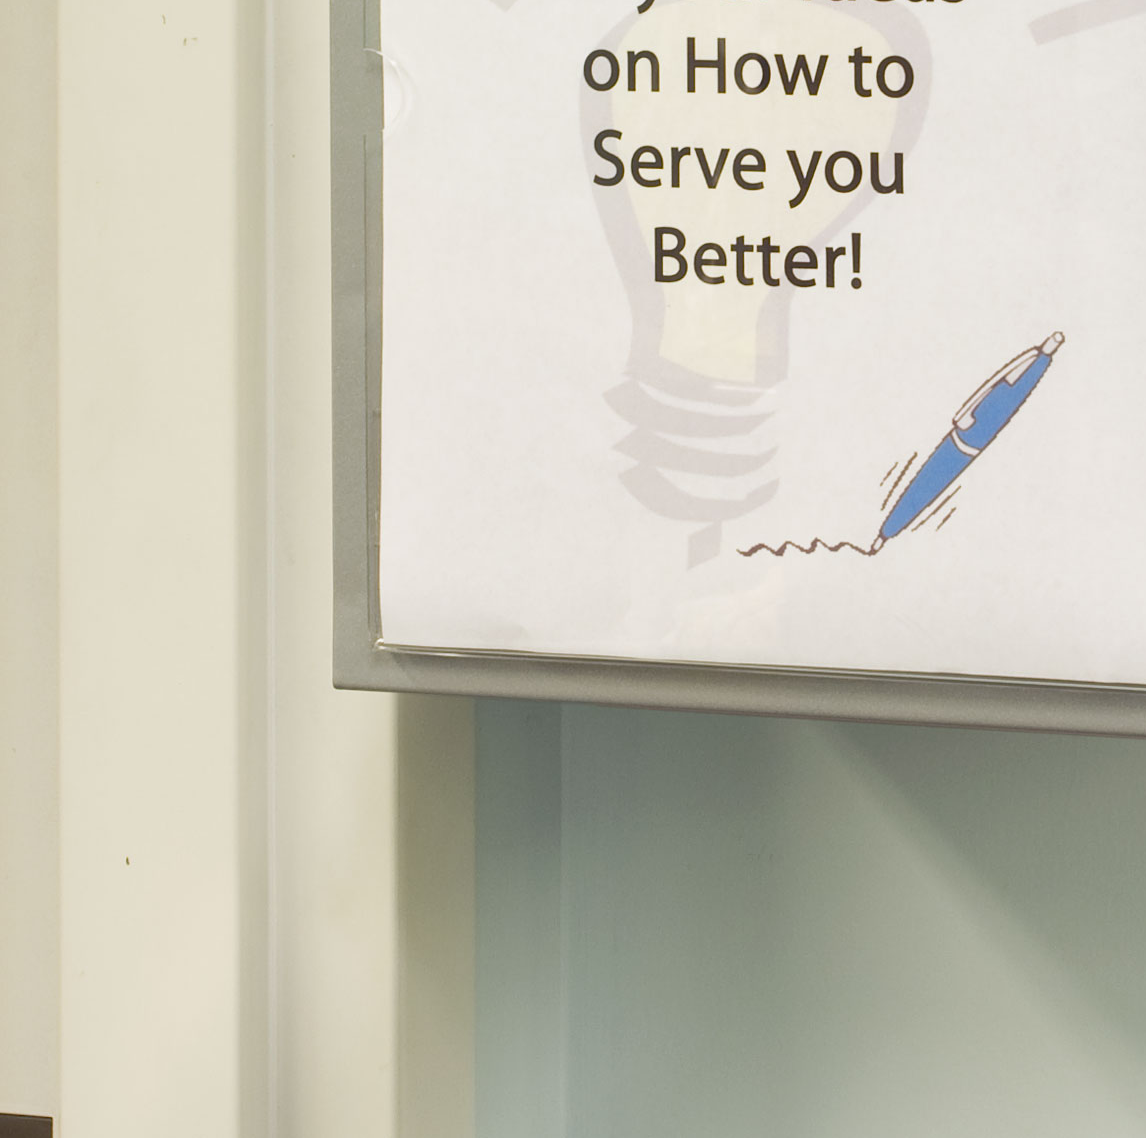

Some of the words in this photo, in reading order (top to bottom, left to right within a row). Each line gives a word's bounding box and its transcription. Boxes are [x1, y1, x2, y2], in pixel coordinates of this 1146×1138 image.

[583, 48, 661, 93] on
[686, 37, 829, 97] How
[848, 46, 915, 100] to
[593, 129, 767, 192] Serve
[786, 145, 905, 210] you
[653, 225, 864, 291] Better!
